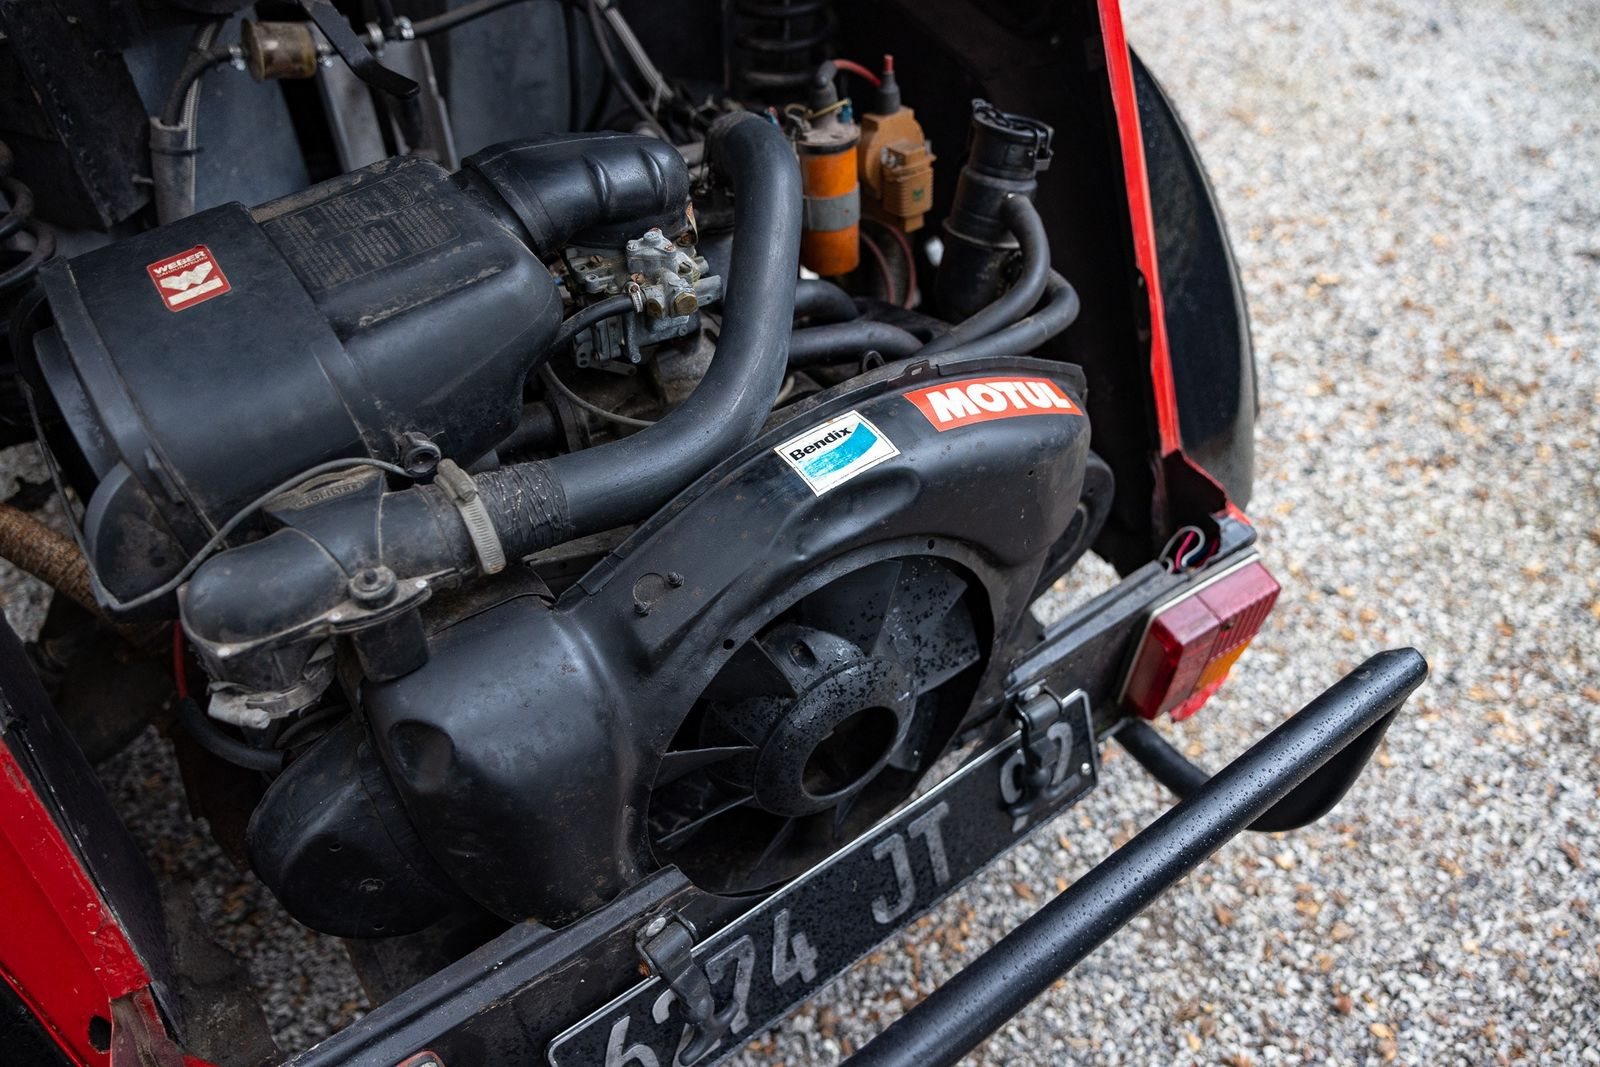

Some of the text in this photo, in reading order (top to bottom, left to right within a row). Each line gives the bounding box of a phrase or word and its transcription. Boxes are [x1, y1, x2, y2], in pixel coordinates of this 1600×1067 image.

[153, 250, 206, 274] WEBER
[925, 381, 1073, 423] MOTUL
[789, 425, 853, 461] Bendix
[871, 800, 950, 924] JT
